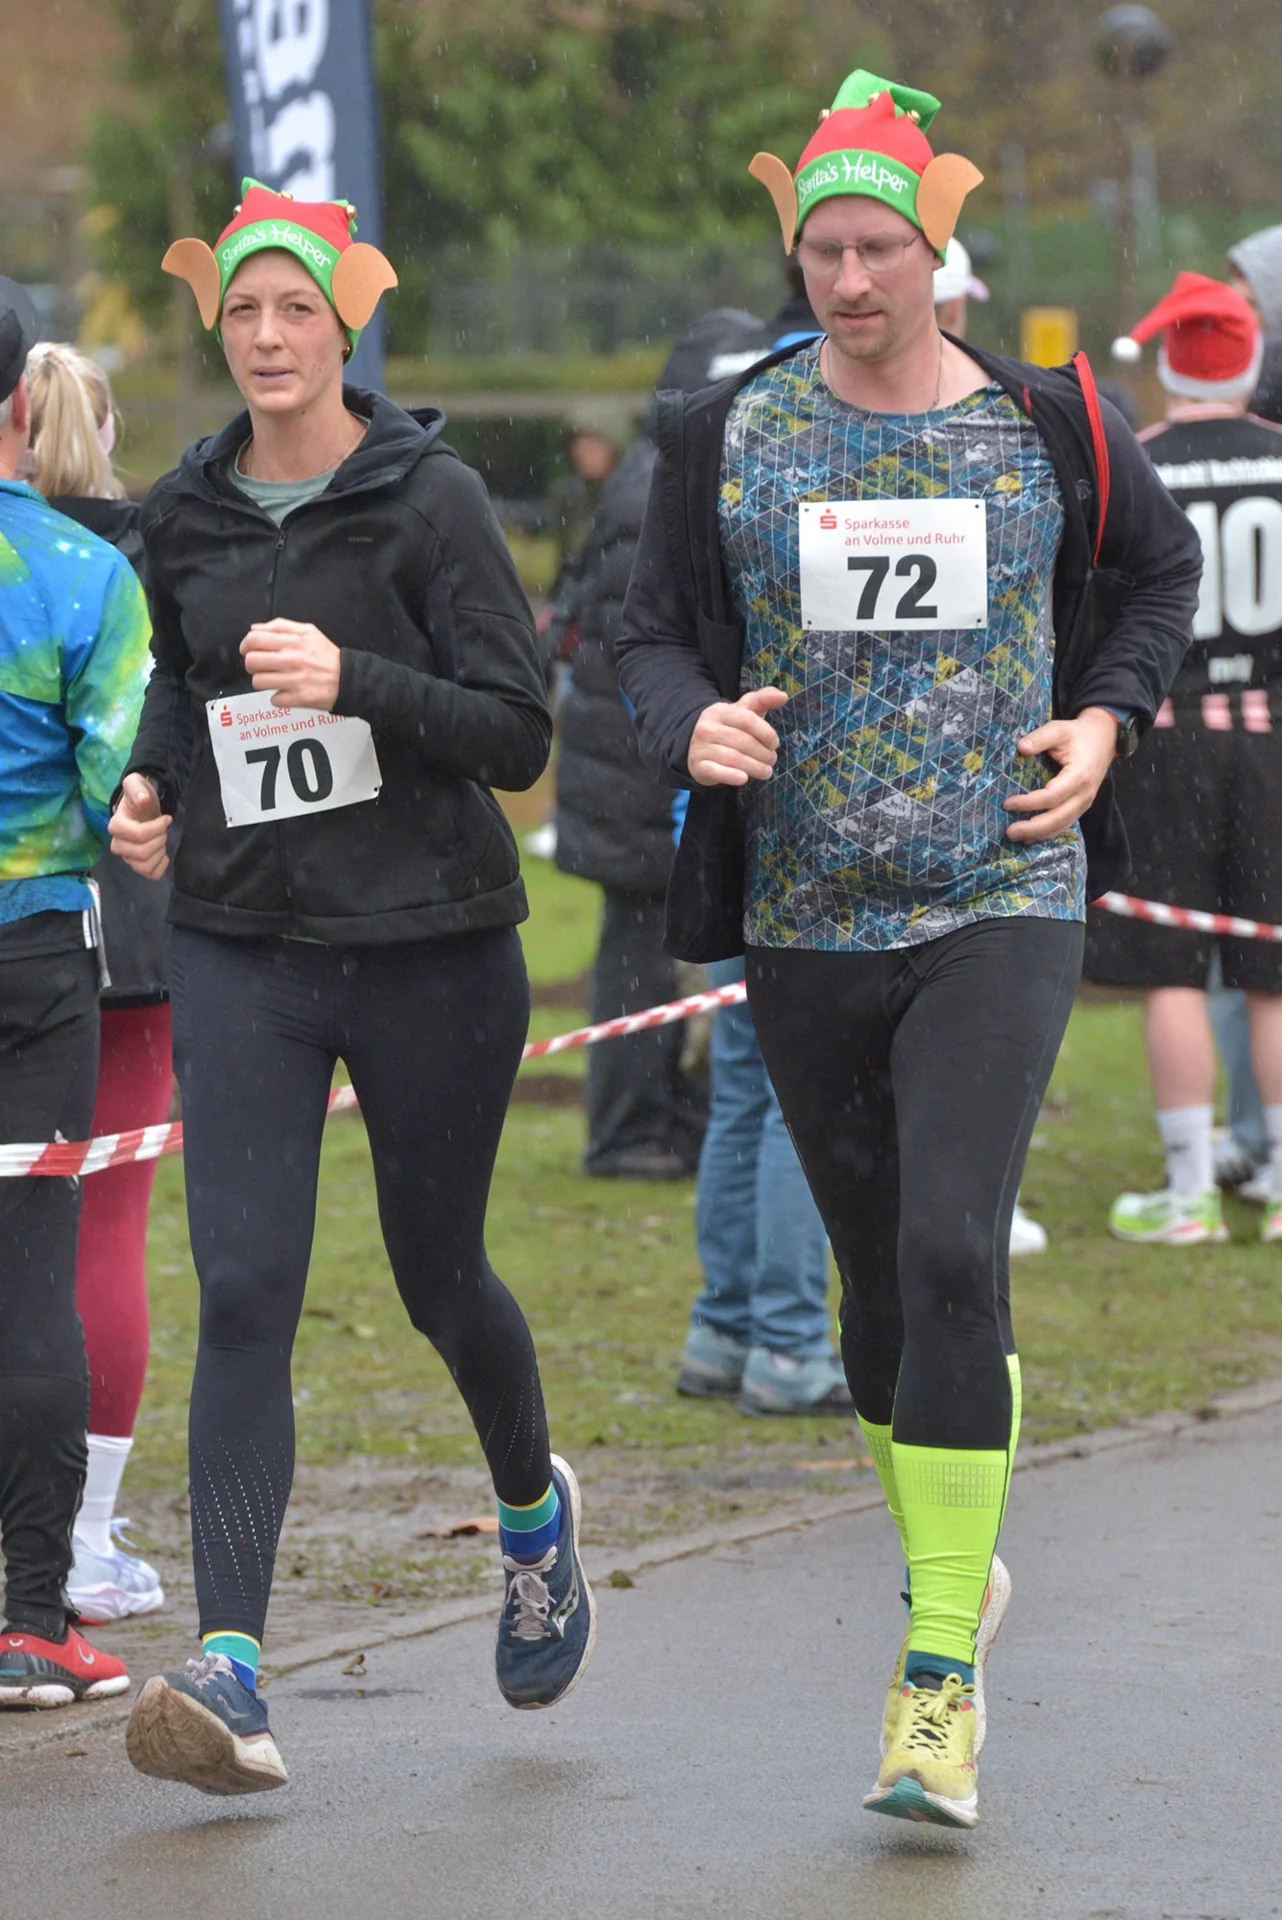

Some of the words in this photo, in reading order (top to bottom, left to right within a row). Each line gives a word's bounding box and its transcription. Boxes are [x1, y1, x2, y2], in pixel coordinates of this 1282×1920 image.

[798, 162, 839, 204] Santa's
[841, 153, 908, 193] Helper
[222, 228, 266, 271] Santa's
[270, 223, 331, 267] Helper
[845, 517, 909, 531] Sparkasse
[845, 535, 860, 546] an
[863, 534, 903, 545] Volme
[907, 533, 931, 545] und
[935, 533, 965, 544] Ruhr
[847, 554, 938, 620] 72
[237, 706, 291, 726] Sparkasse
[240, 731, 252, 741] an
[253, 724, 289, 738] Volme
[292, 717, 315, 732] und
[245, 738, 333, 811] 70
